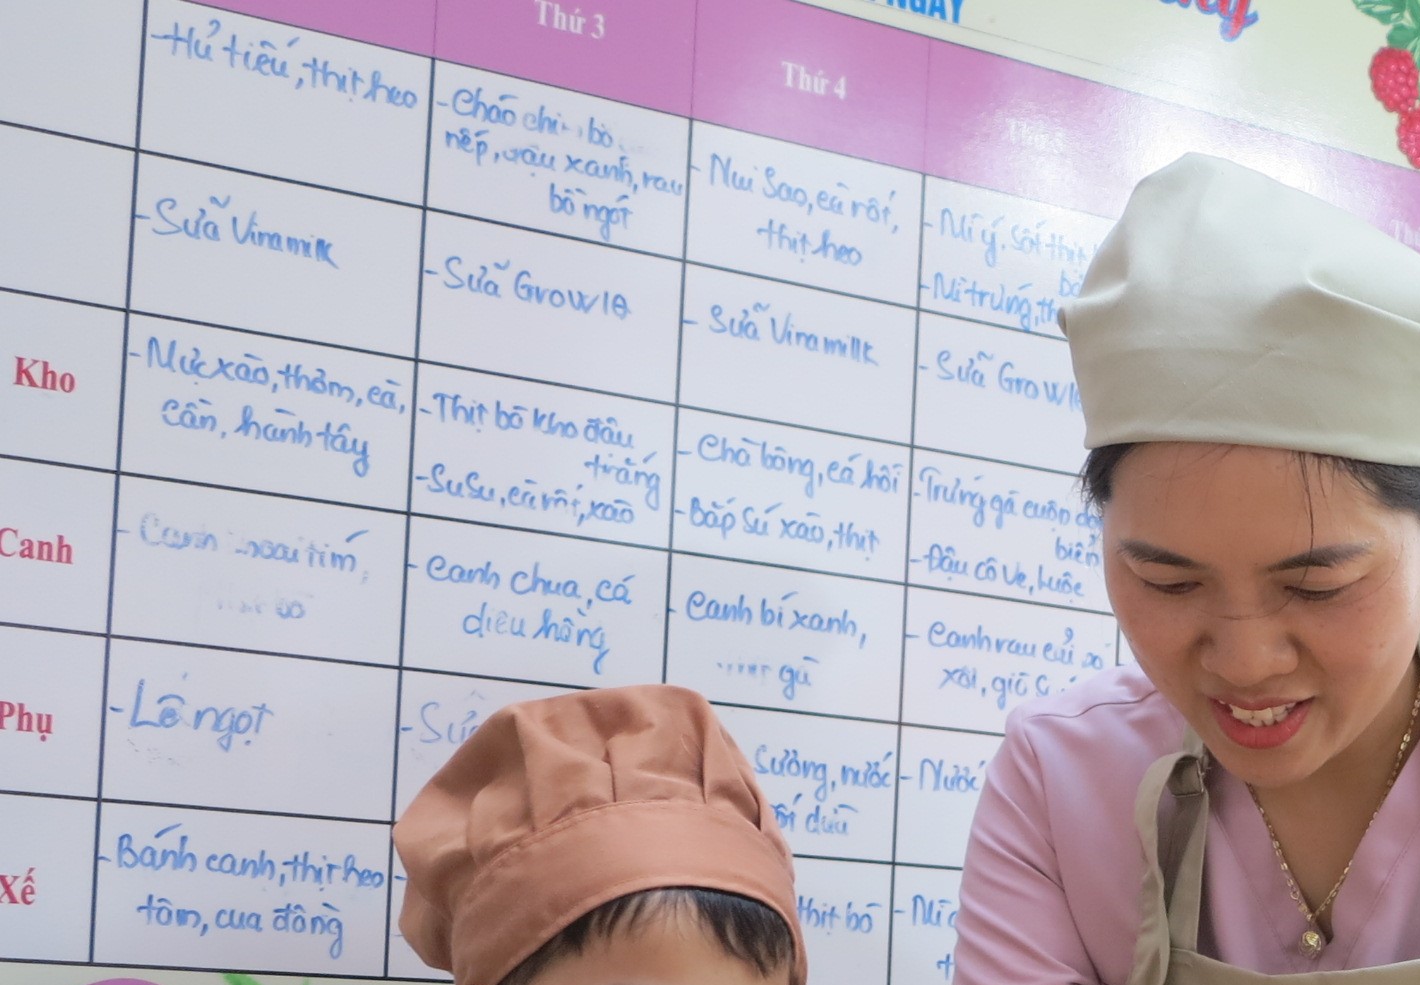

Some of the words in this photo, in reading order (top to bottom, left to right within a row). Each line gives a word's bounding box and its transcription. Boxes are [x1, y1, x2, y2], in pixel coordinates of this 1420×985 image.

[533, 0, 586, 35] Thứ
[590, 14, 606, 40] 3
[781, 60, 831, 96] Thứ
[833, 76, 847, 100] 4
[12, 355, 76, 394] Kho
[0, 526, 74, 566] Canh
[0, 700, 54, 743] Phụ
[0, 867, 36, 906] Xế
[215, 905, 263, 933] cua
